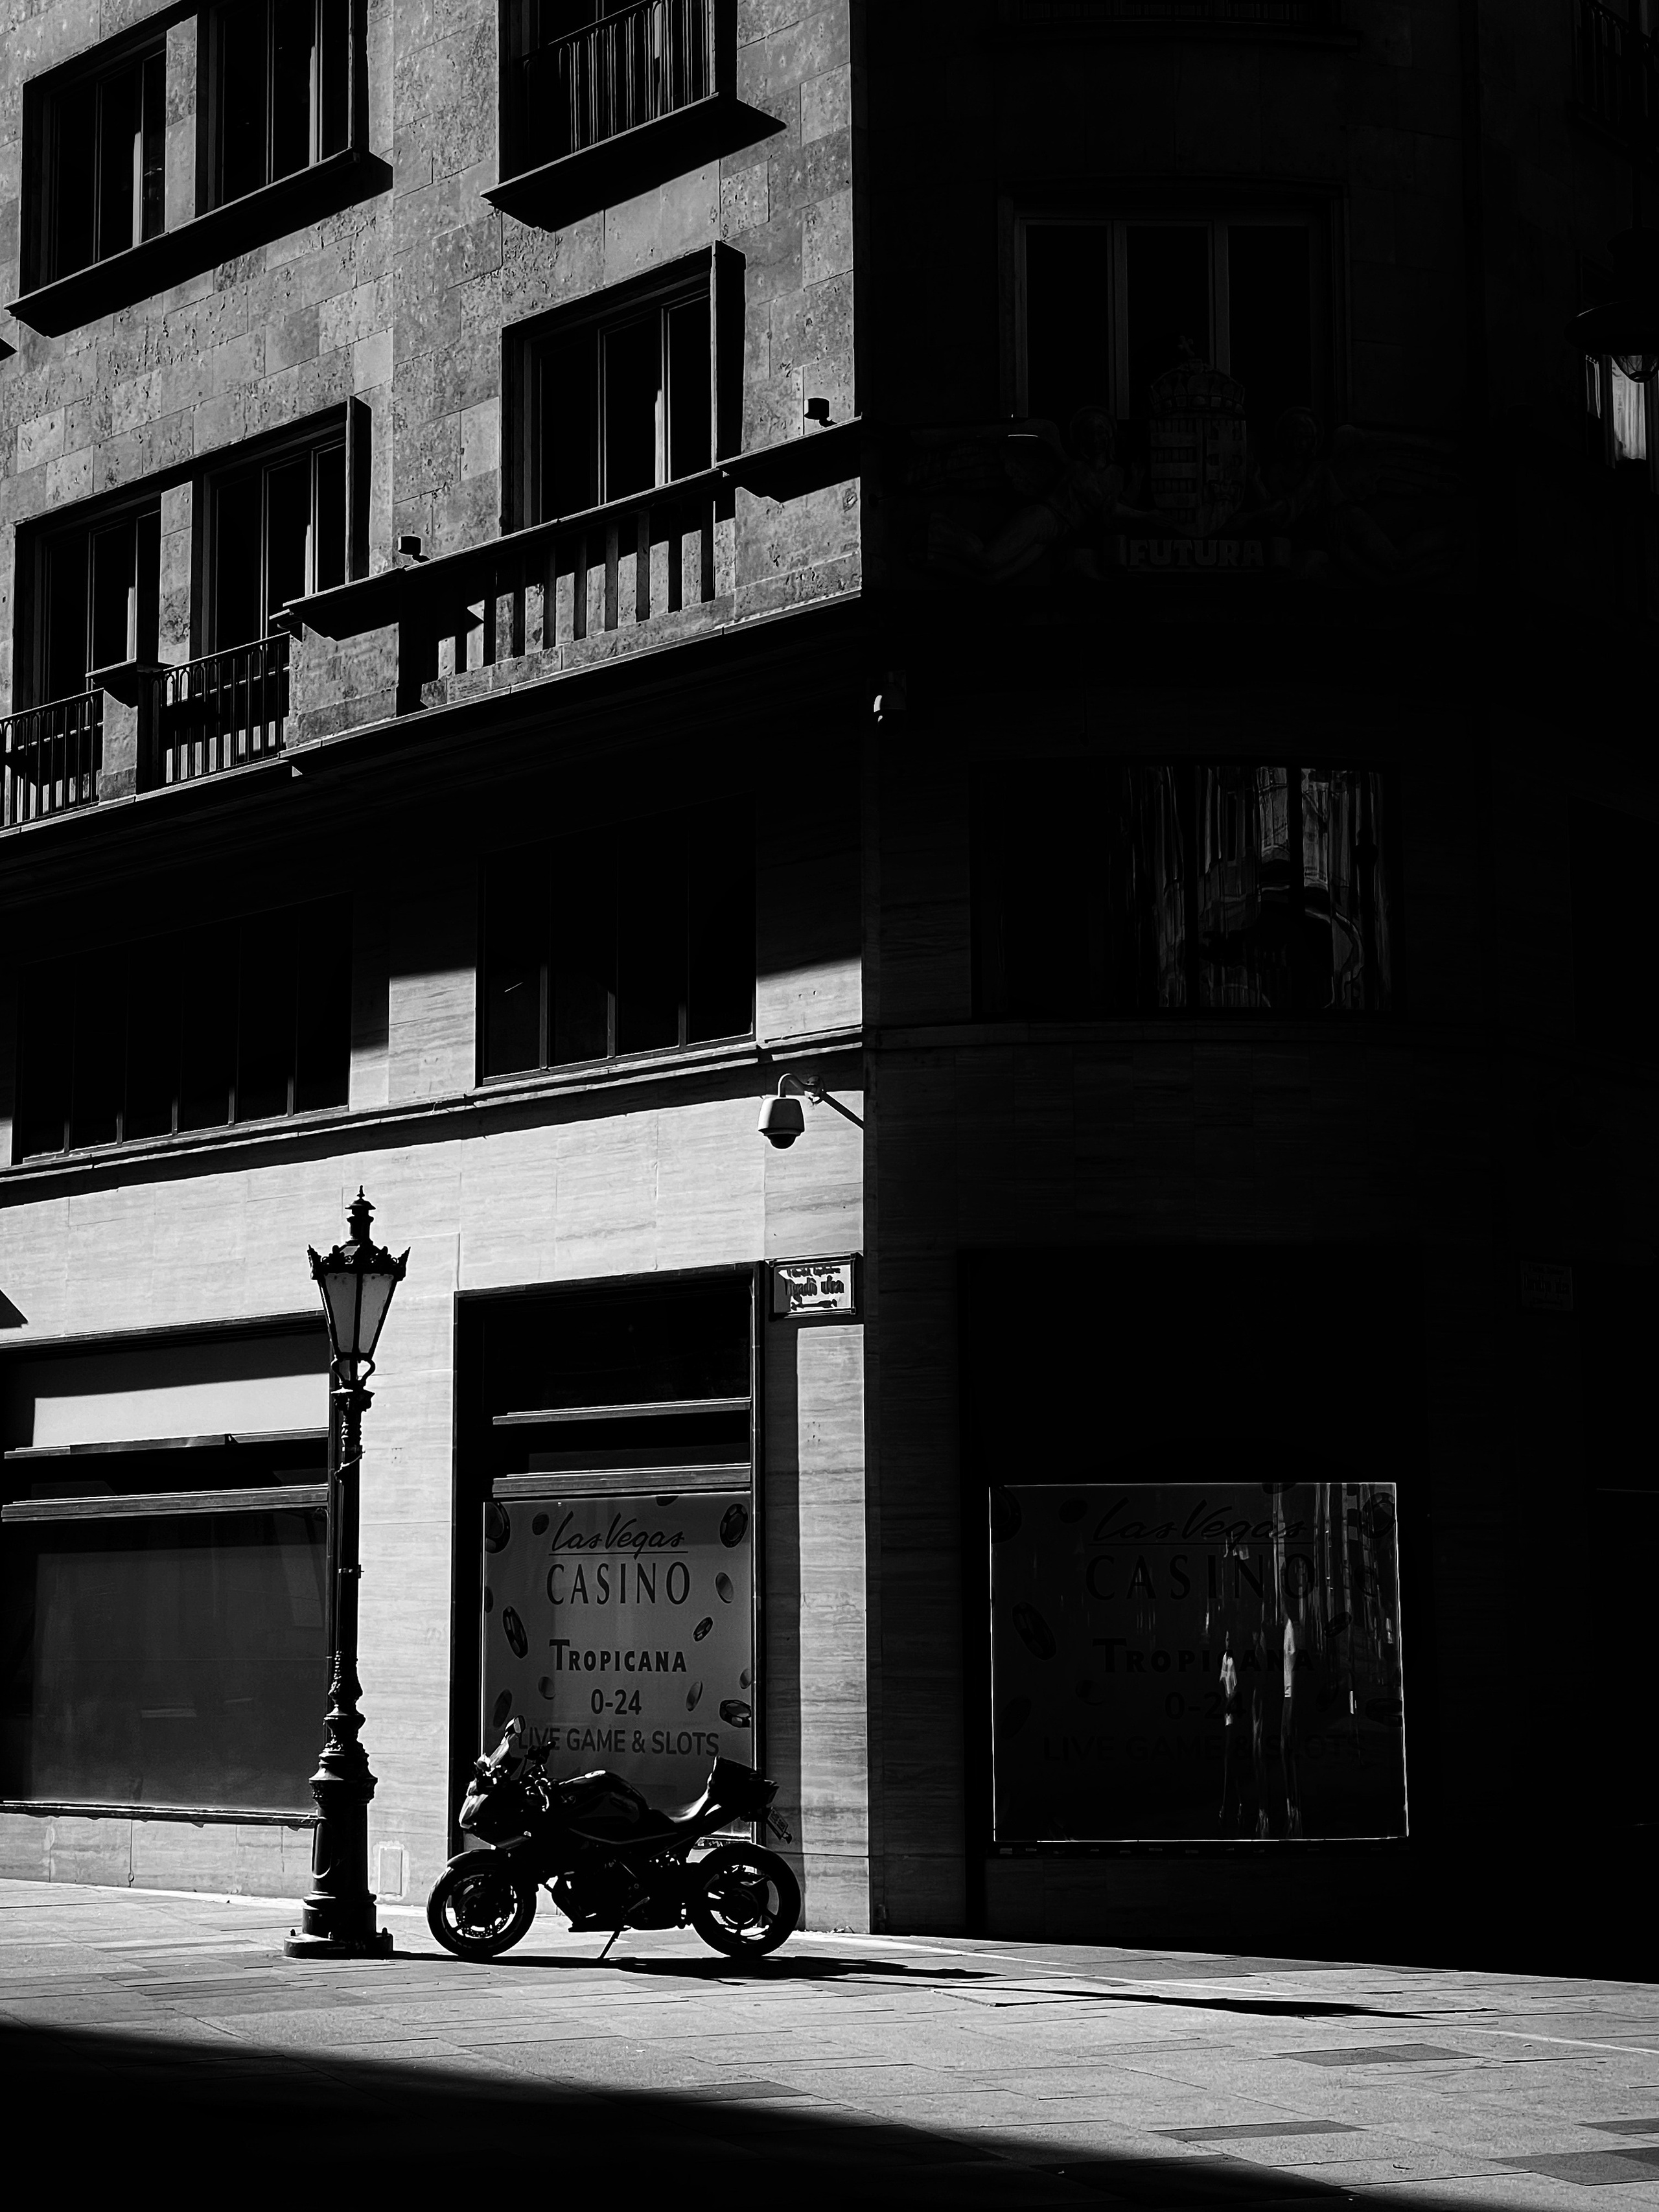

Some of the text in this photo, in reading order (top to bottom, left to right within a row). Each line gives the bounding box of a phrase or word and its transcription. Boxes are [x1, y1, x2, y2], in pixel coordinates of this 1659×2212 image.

[1130, 540, 1264, 566] FUTURA
[551, 1511, 684, 1559] Las Vegas
[1093, 1497, 1307, 1551] Las Vegas
[546, 1561, 690, 1605] CASINO
[1085, 1553, 1316, 1601] CASINO
[549, 1639, 687, 1672] TROPICANA
[591, 1688, 642, 1716] 0-24
[1165, 1692, 1247, 1721] 0-24
[519, 1727, 719, 1756] LIVE GAME & SLOTS
[1043, 1736, 1114, 1762] LIVE
[1126, 1736, 1224, 1761] GAME
